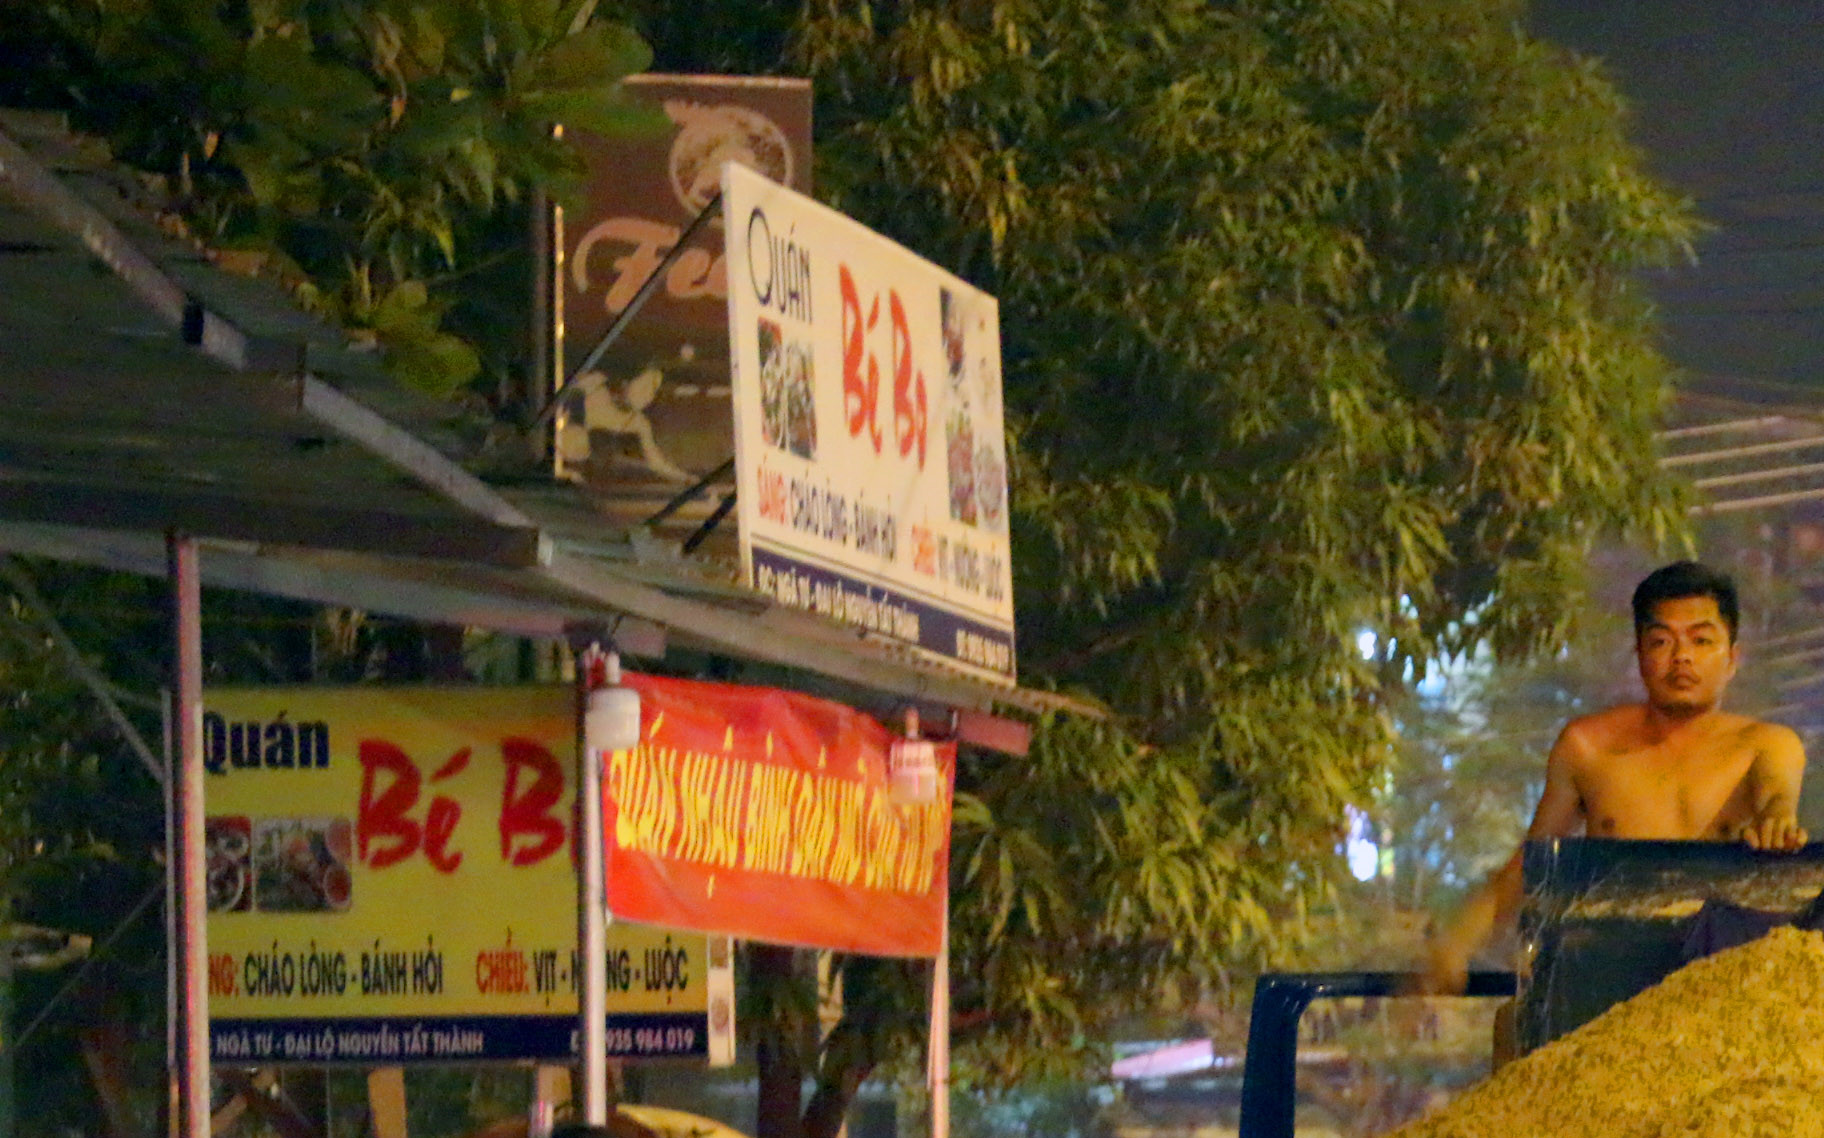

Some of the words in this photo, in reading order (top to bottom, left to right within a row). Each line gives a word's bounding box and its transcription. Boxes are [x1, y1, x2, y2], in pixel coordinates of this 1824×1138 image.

[839, 260, 882, 456] Bé
[203, 711, 330, 775] Quán
[357, 738, 471, 875] Bé
[500, 737, 580, 868] B
[244, 938, 294, 996] CHÁO
[301, 938, 347, 995] LÒNG
[361, 938, 407, 995] BÁNH
[413, 934, 443, 995] HỎI
